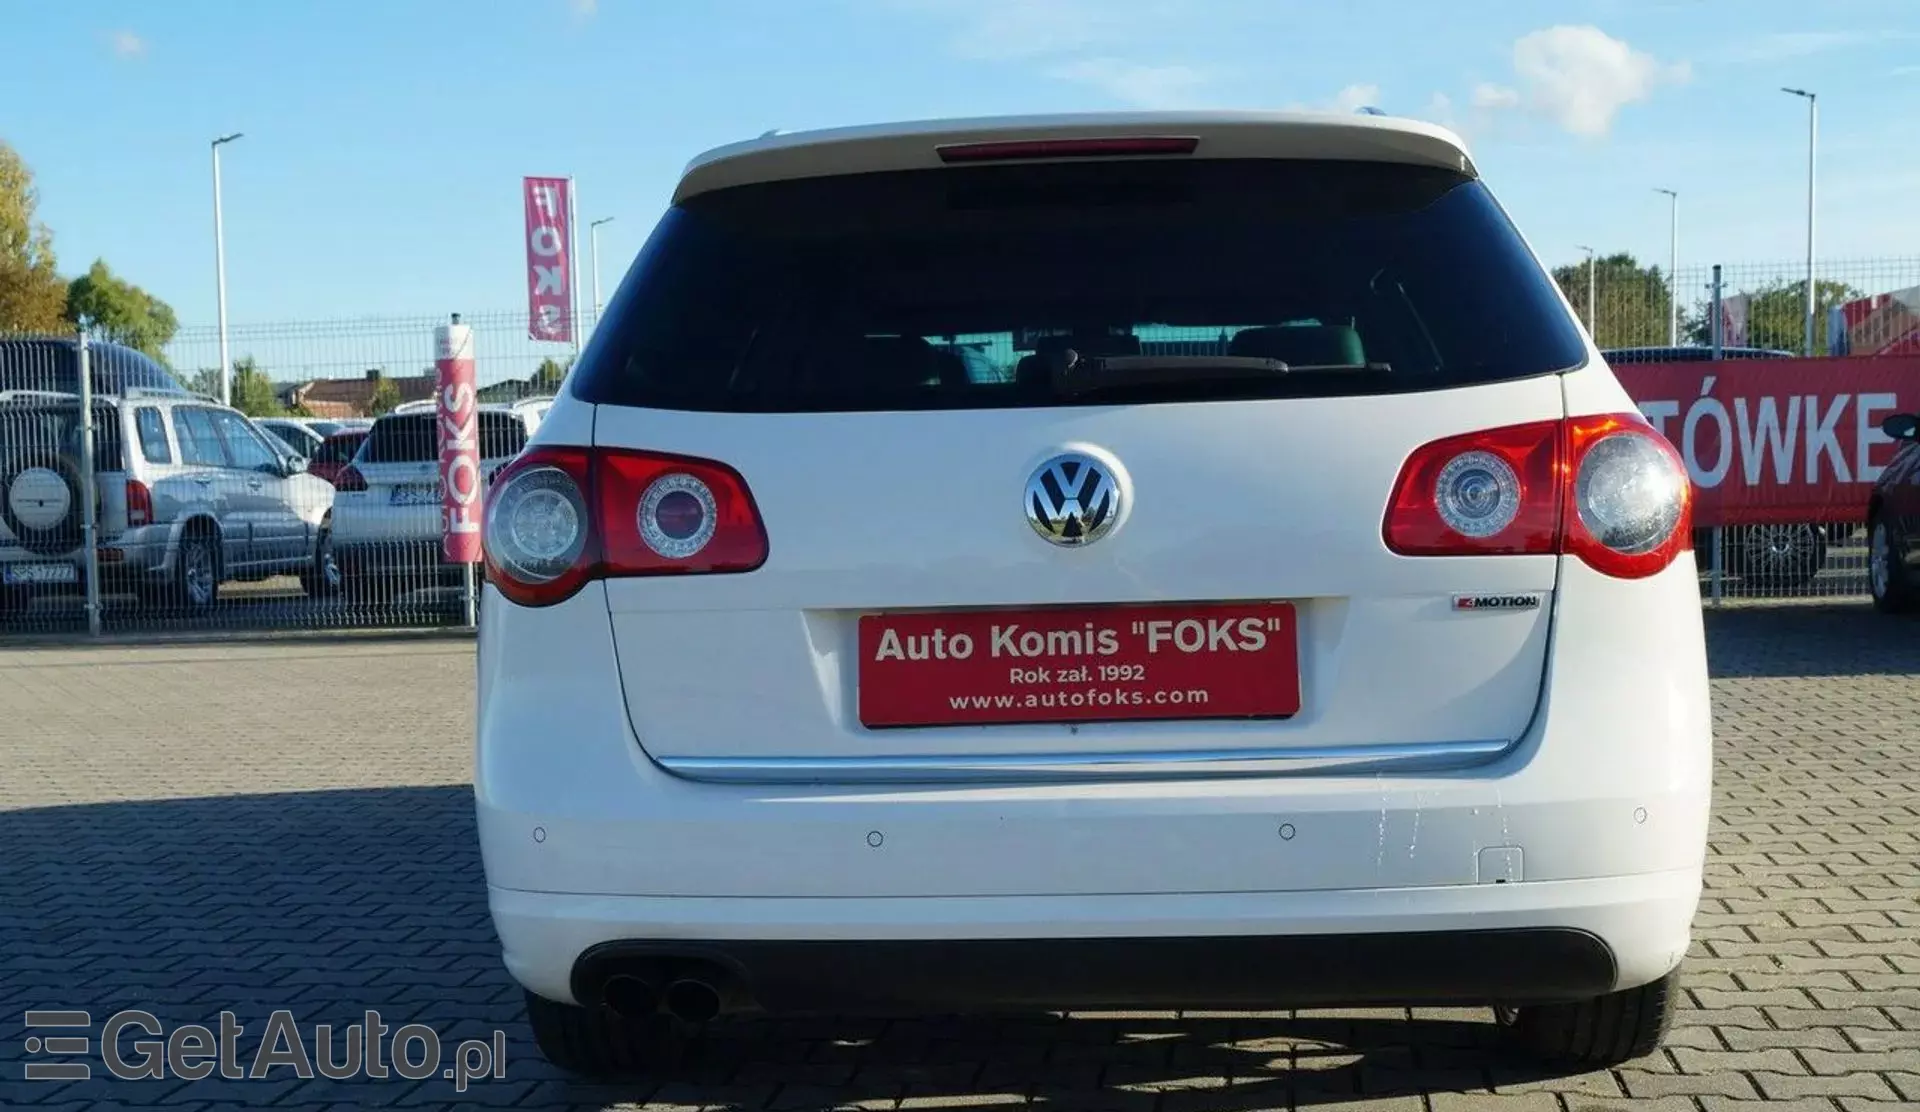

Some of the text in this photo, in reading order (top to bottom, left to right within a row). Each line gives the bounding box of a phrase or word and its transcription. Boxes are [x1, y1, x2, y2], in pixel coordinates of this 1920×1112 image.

[444, 381, 480, 534] FOKS
[1458, 596, 1536, 608] 4MOTION
[875, 618, 1281, 661] Auto Komis "FOKS"
[1009, 664, 1146, 684] Rok zał. 1992
[949, 688, 1210, 710] www.autofoks.com
